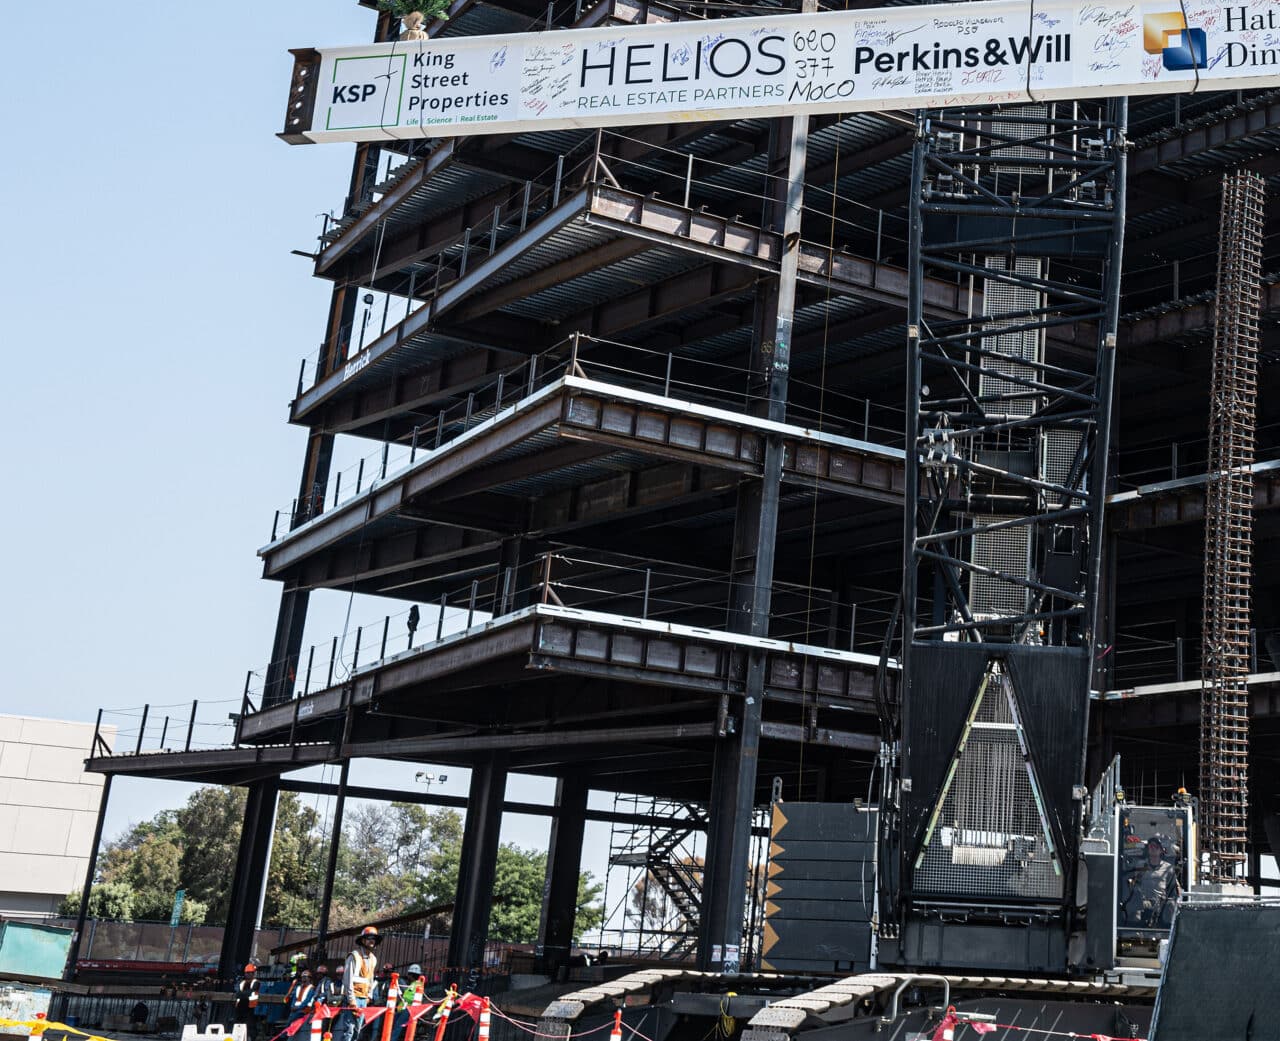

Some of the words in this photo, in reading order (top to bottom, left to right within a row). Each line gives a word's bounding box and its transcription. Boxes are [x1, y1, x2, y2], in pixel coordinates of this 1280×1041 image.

[413, 51, 455, 69] King
[579, 35, 786, 88] HELIOS
[854, 33, 1071, 74] Perkins&Will
[795, 57, 835, 78] 377
[411, 71, 470, 89] Street
[332, 82, 376, 105] KSP
[408, 91, 510, 112] Properties
[578, 92, 622, 109] REAL
[627, 89, 687, 106] ESTATE
[693, 84, 784, 101] PARTNERS
[427, 117, 453, 125] Science
[461, 115, 476, 123] Real
